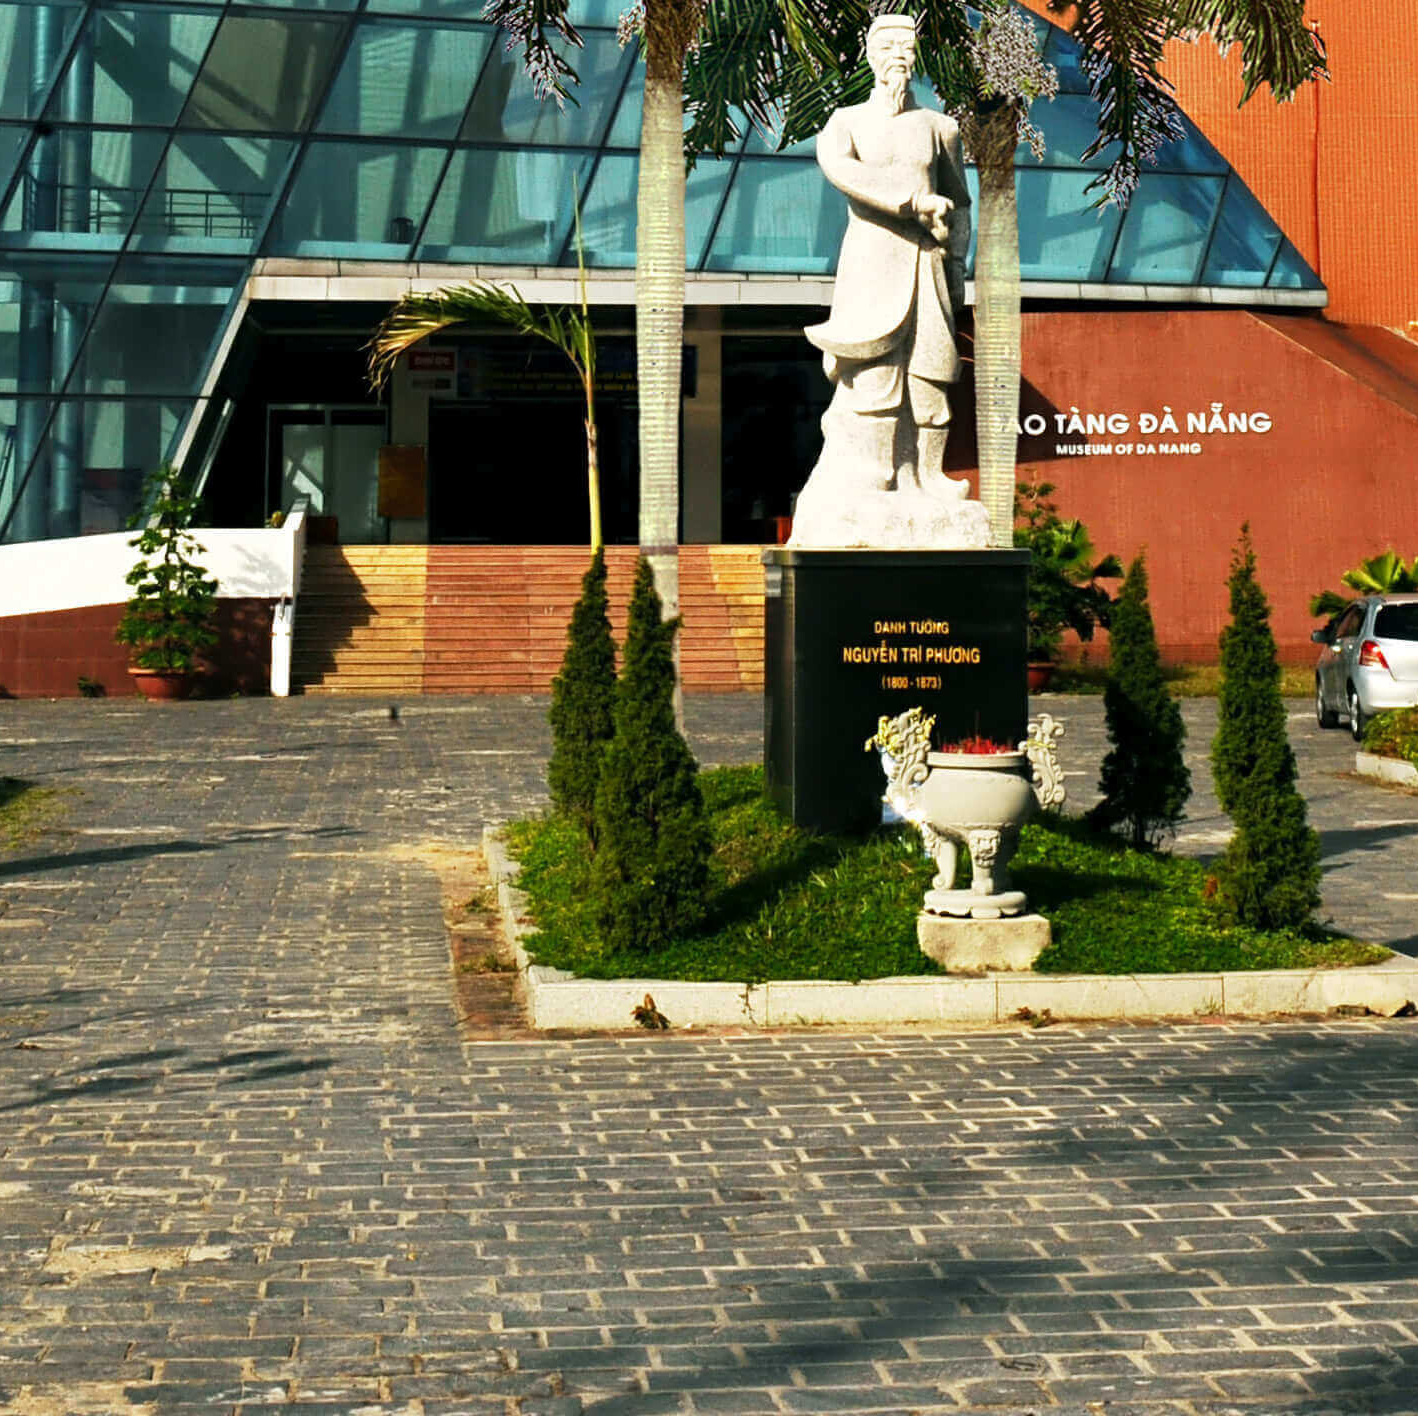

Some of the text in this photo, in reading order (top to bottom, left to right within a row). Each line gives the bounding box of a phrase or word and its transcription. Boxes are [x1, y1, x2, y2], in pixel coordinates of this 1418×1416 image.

[1054, 406, 1130, 434] TÀNG
[1138, 405, 1179, 434] ĐÀ
[1187, 402, 1273, 434] NẴNG
[1055, 442, 1202, 455] MUSEUM OF DA NANG
[874, 620, 907, 634] DANH
[925, 645, 981, 664] PHƯƠNG
